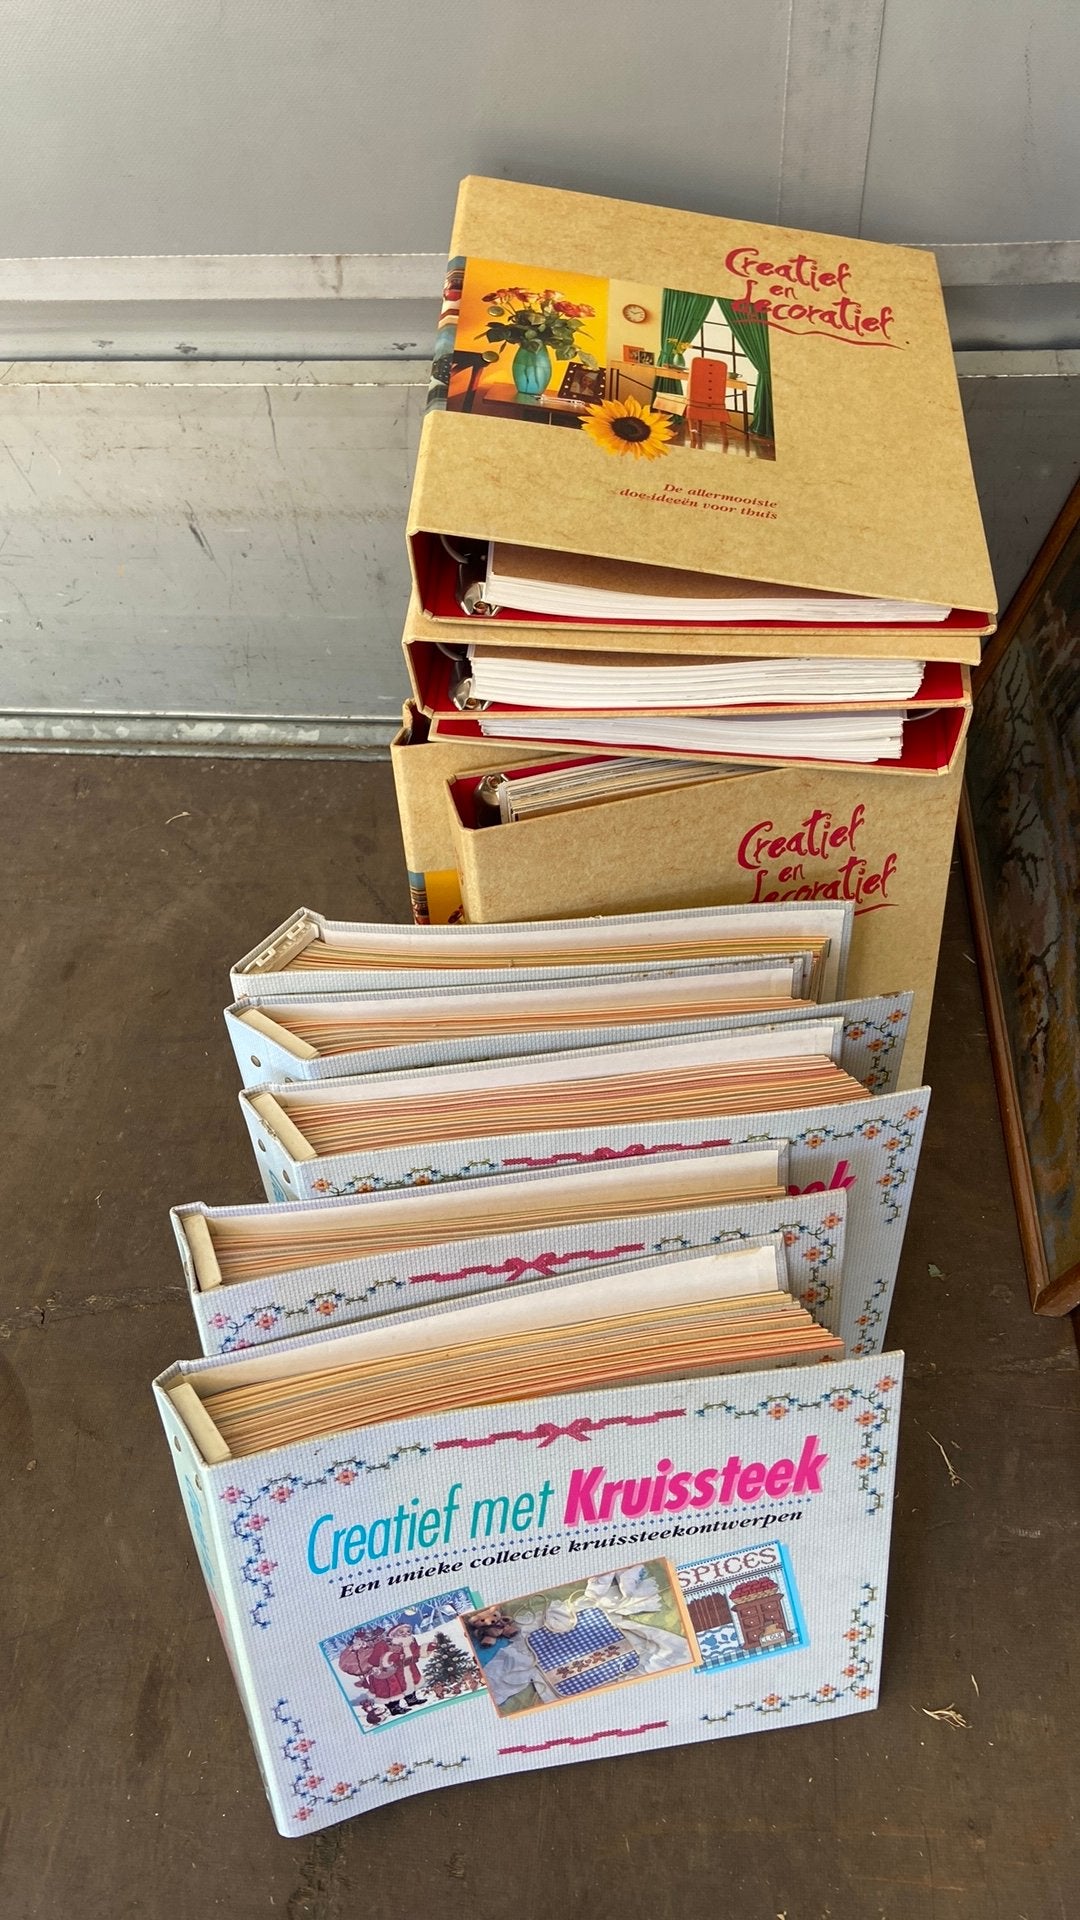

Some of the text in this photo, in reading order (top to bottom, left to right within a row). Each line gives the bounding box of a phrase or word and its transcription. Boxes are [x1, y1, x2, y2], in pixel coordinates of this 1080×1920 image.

[725, 247, 852, 294] Creatief
[769, 285, 798, 300] en
[731, 279, 894, 340] decoratief
[619, 488, 778, 520] doe-ideeën voor thuis
[663, 483, 778, 509] De allermooiste
[737, 803, 865, 870] Creatief
[778, 863, 805, 883] en
[307, 1482, 463, 1576] Creatief
[470, 1480, 555, 1540] met
[563, 1434, 829, 1527] Kruissteek
[339, 1511, 803, 1600] Een unieke collectie kruissteekontwerpen
[677, 1547, 777, 1588] SPICES
